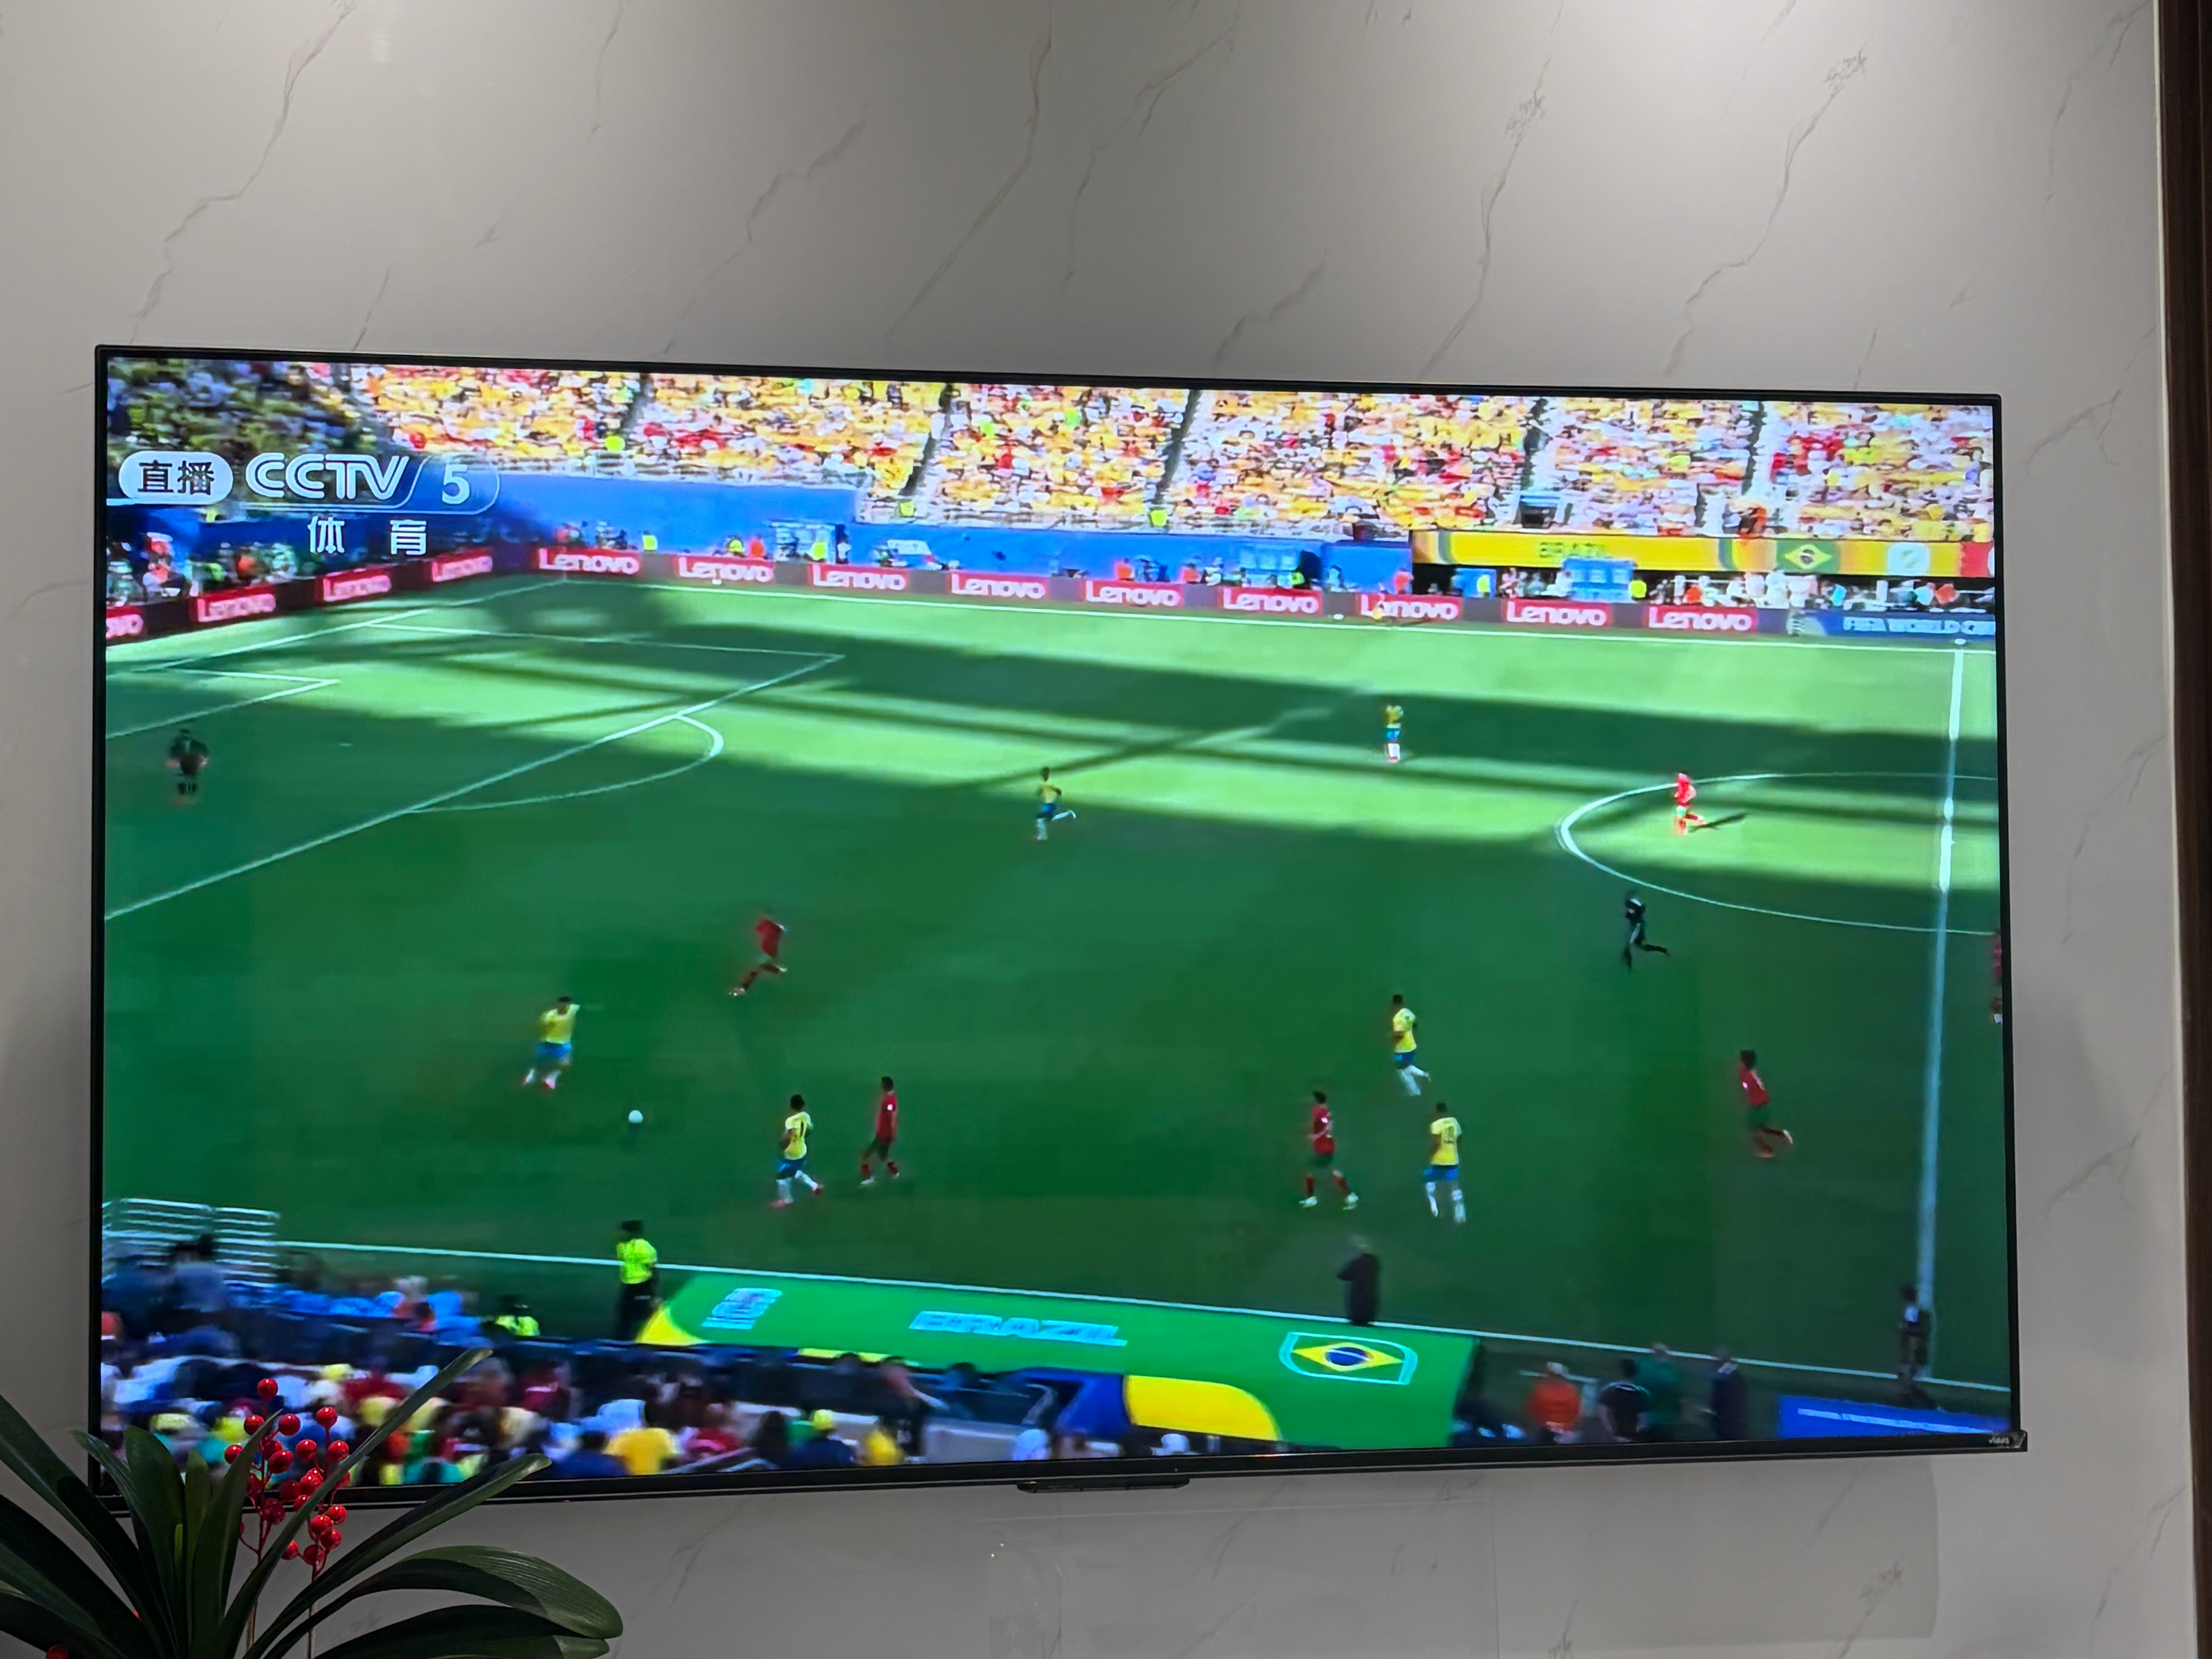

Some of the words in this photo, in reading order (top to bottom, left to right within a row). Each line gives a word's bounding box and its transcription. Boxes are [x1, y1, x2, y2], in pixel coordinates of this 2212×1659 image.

[137, 460, 215, 496] 直播
[246, 453, 410, 499] CCTV
[441, 464, 470, 504] 5
[307, 515, 427, 555] 体育
[539, 548, 640, 575] Lenovo
[678, 556, 773, 582] Lenovo
[812, 563, 907, 591] Lenovo
[951, 574, 1045, 599] Lenovo
[1086, 581, 1179, 606] Lenovo
[1223, 587, 1319, 613] Lenovo
[1506, 601, 1607, 626] Lenovo
[1648, 607, 1753, 631] Lenovo
